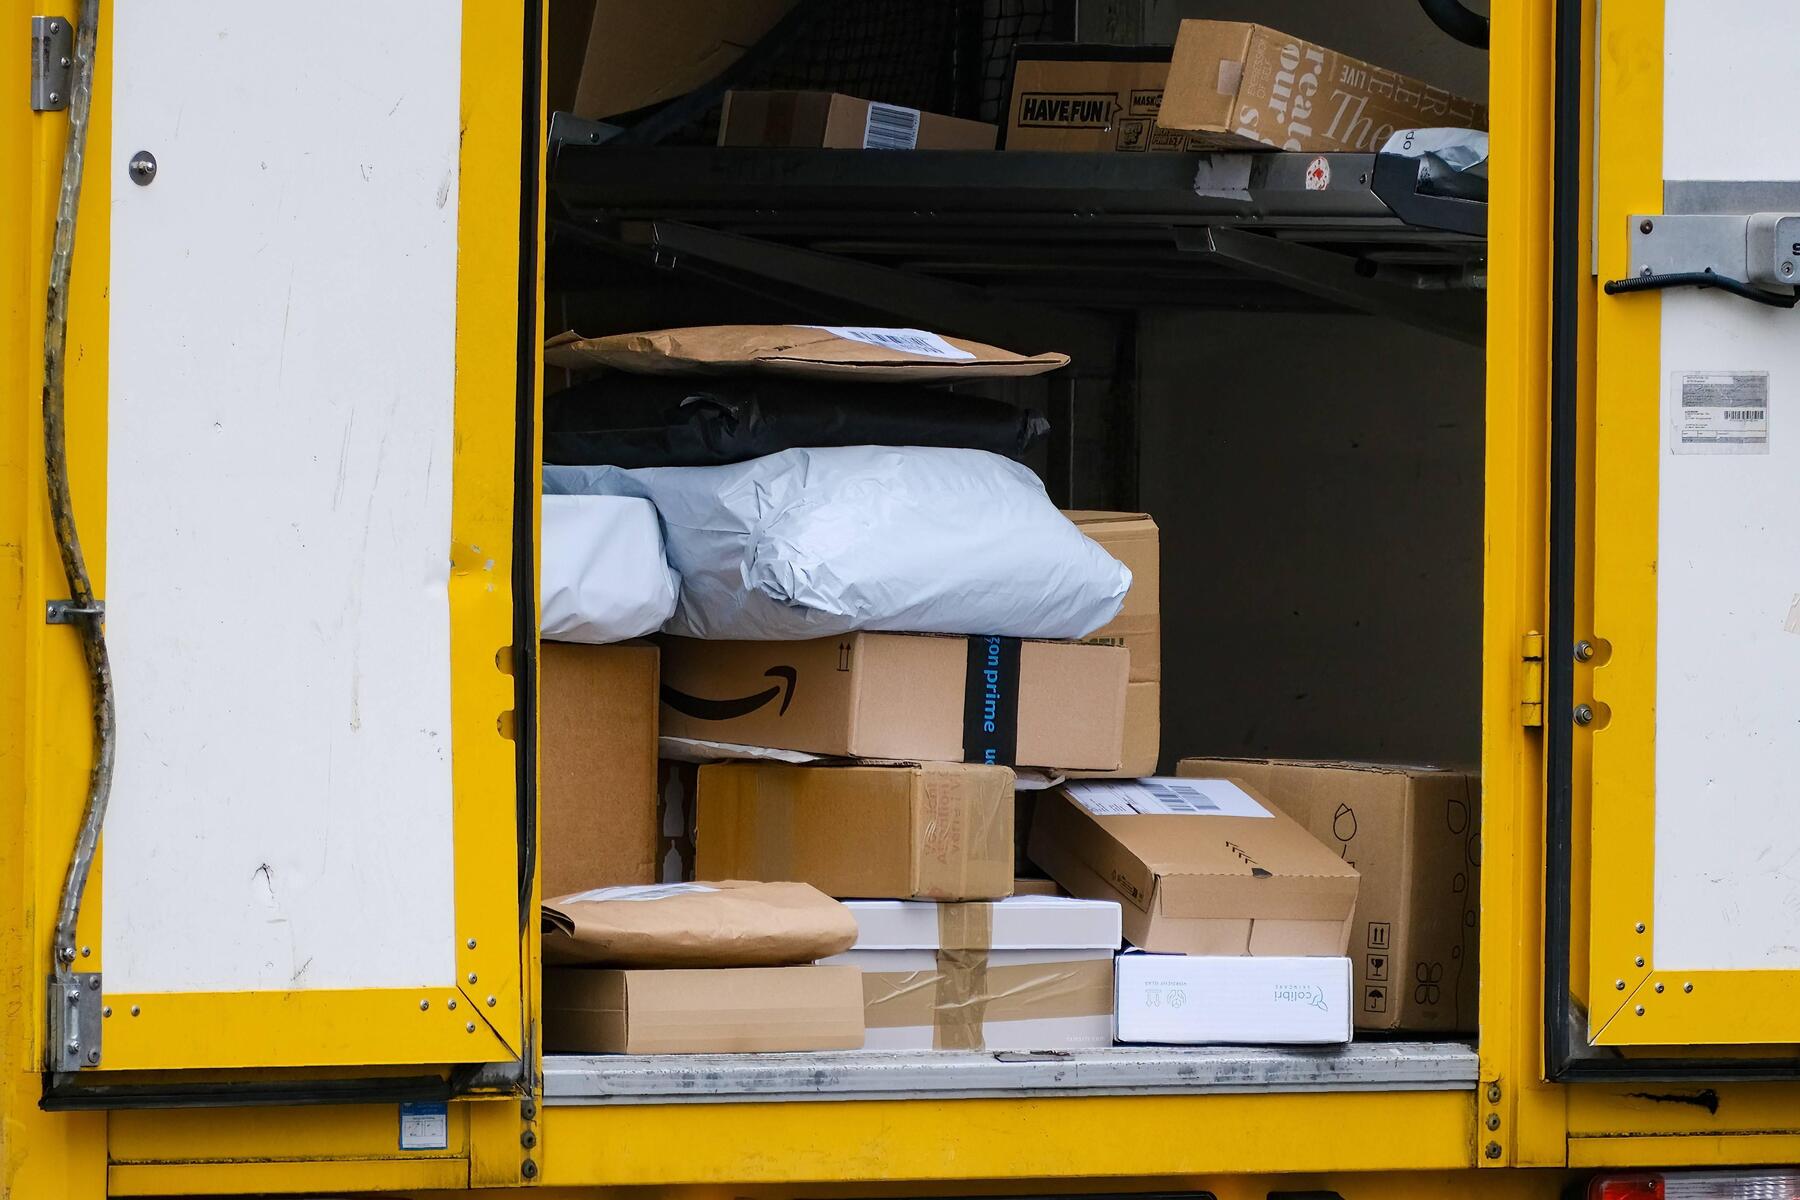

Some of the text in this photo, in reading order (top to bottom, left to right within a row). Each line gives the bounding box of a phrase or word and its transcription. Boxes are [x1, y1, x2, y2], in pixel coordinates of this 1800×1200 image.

[1340, 65, 1366, 89] LIVE
[1023, 99, 1070, 121] HAVE
[1320, 88, 1394, 151] The
[984, 669, 1000, 733] prime
[1274, 991, 1312, 1002] colibri
